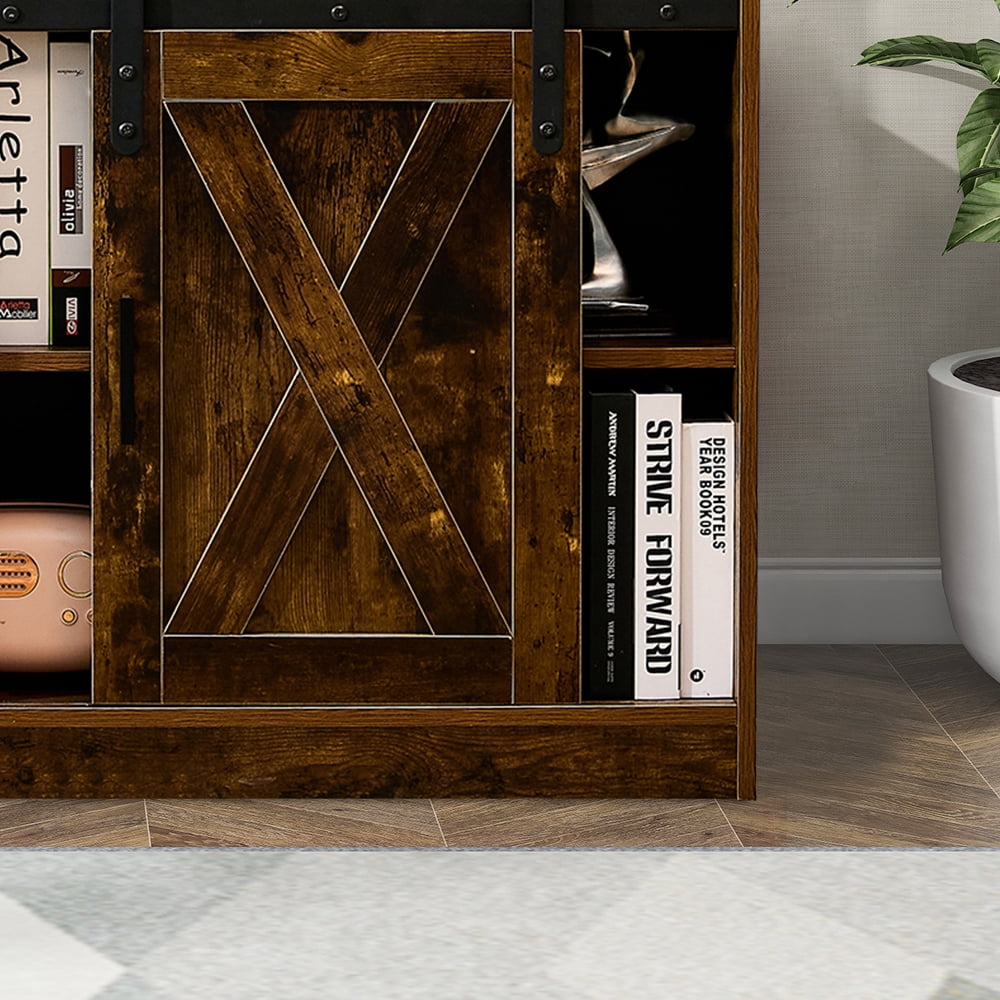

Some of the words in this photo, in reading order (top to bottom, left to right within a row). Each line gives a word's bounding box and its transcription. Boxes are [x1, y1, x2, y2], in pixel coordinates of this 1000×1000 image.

[60, 189, 75, 232] olivia
[608, 411, 617, 456] ANDREW
[646, 420, 673, 515] STRIVE
[699, 437, 713, 474] YEAR
[712, 437, 726, 489] DESIGN
[608, 457, 616, 497] MARTIN
[607, 506, 616, 546] INTERIOR
[607, 549, 615, 579] DESIGN
[607, 582, 615, 614] REVIEW
[645, 534, 673, 674] FORWARD
